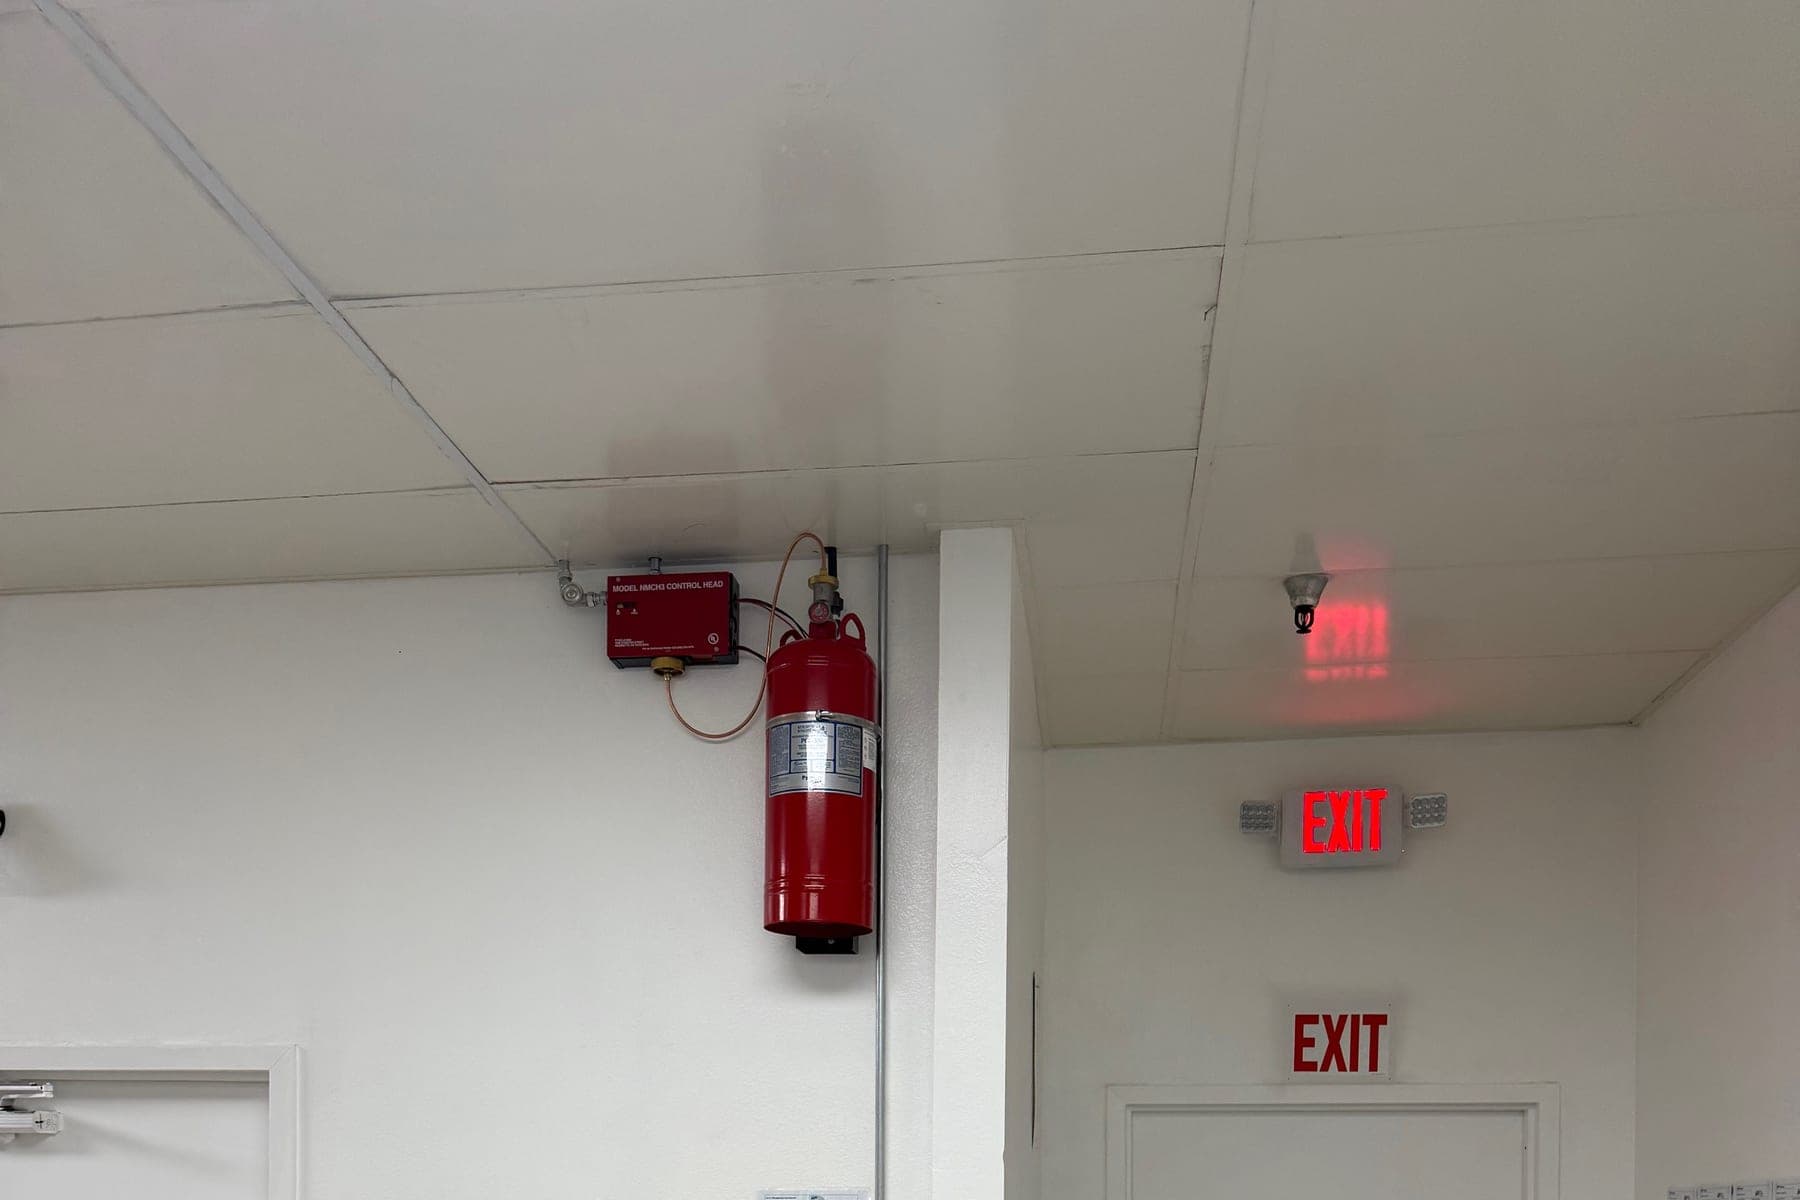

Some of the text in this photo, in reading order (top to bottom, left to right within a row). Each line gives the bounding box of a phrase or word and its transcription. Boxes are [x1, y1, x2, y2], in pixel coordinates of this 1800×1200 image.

[612, 585, 638, 593] MODEL
[666, 582, 702, 590] CONTROL
[703, 580, 724, 589] HEAD
[1302, 788, 1388, 854] EXIT
[1293, 1013, 1388, 1073] EXIT
